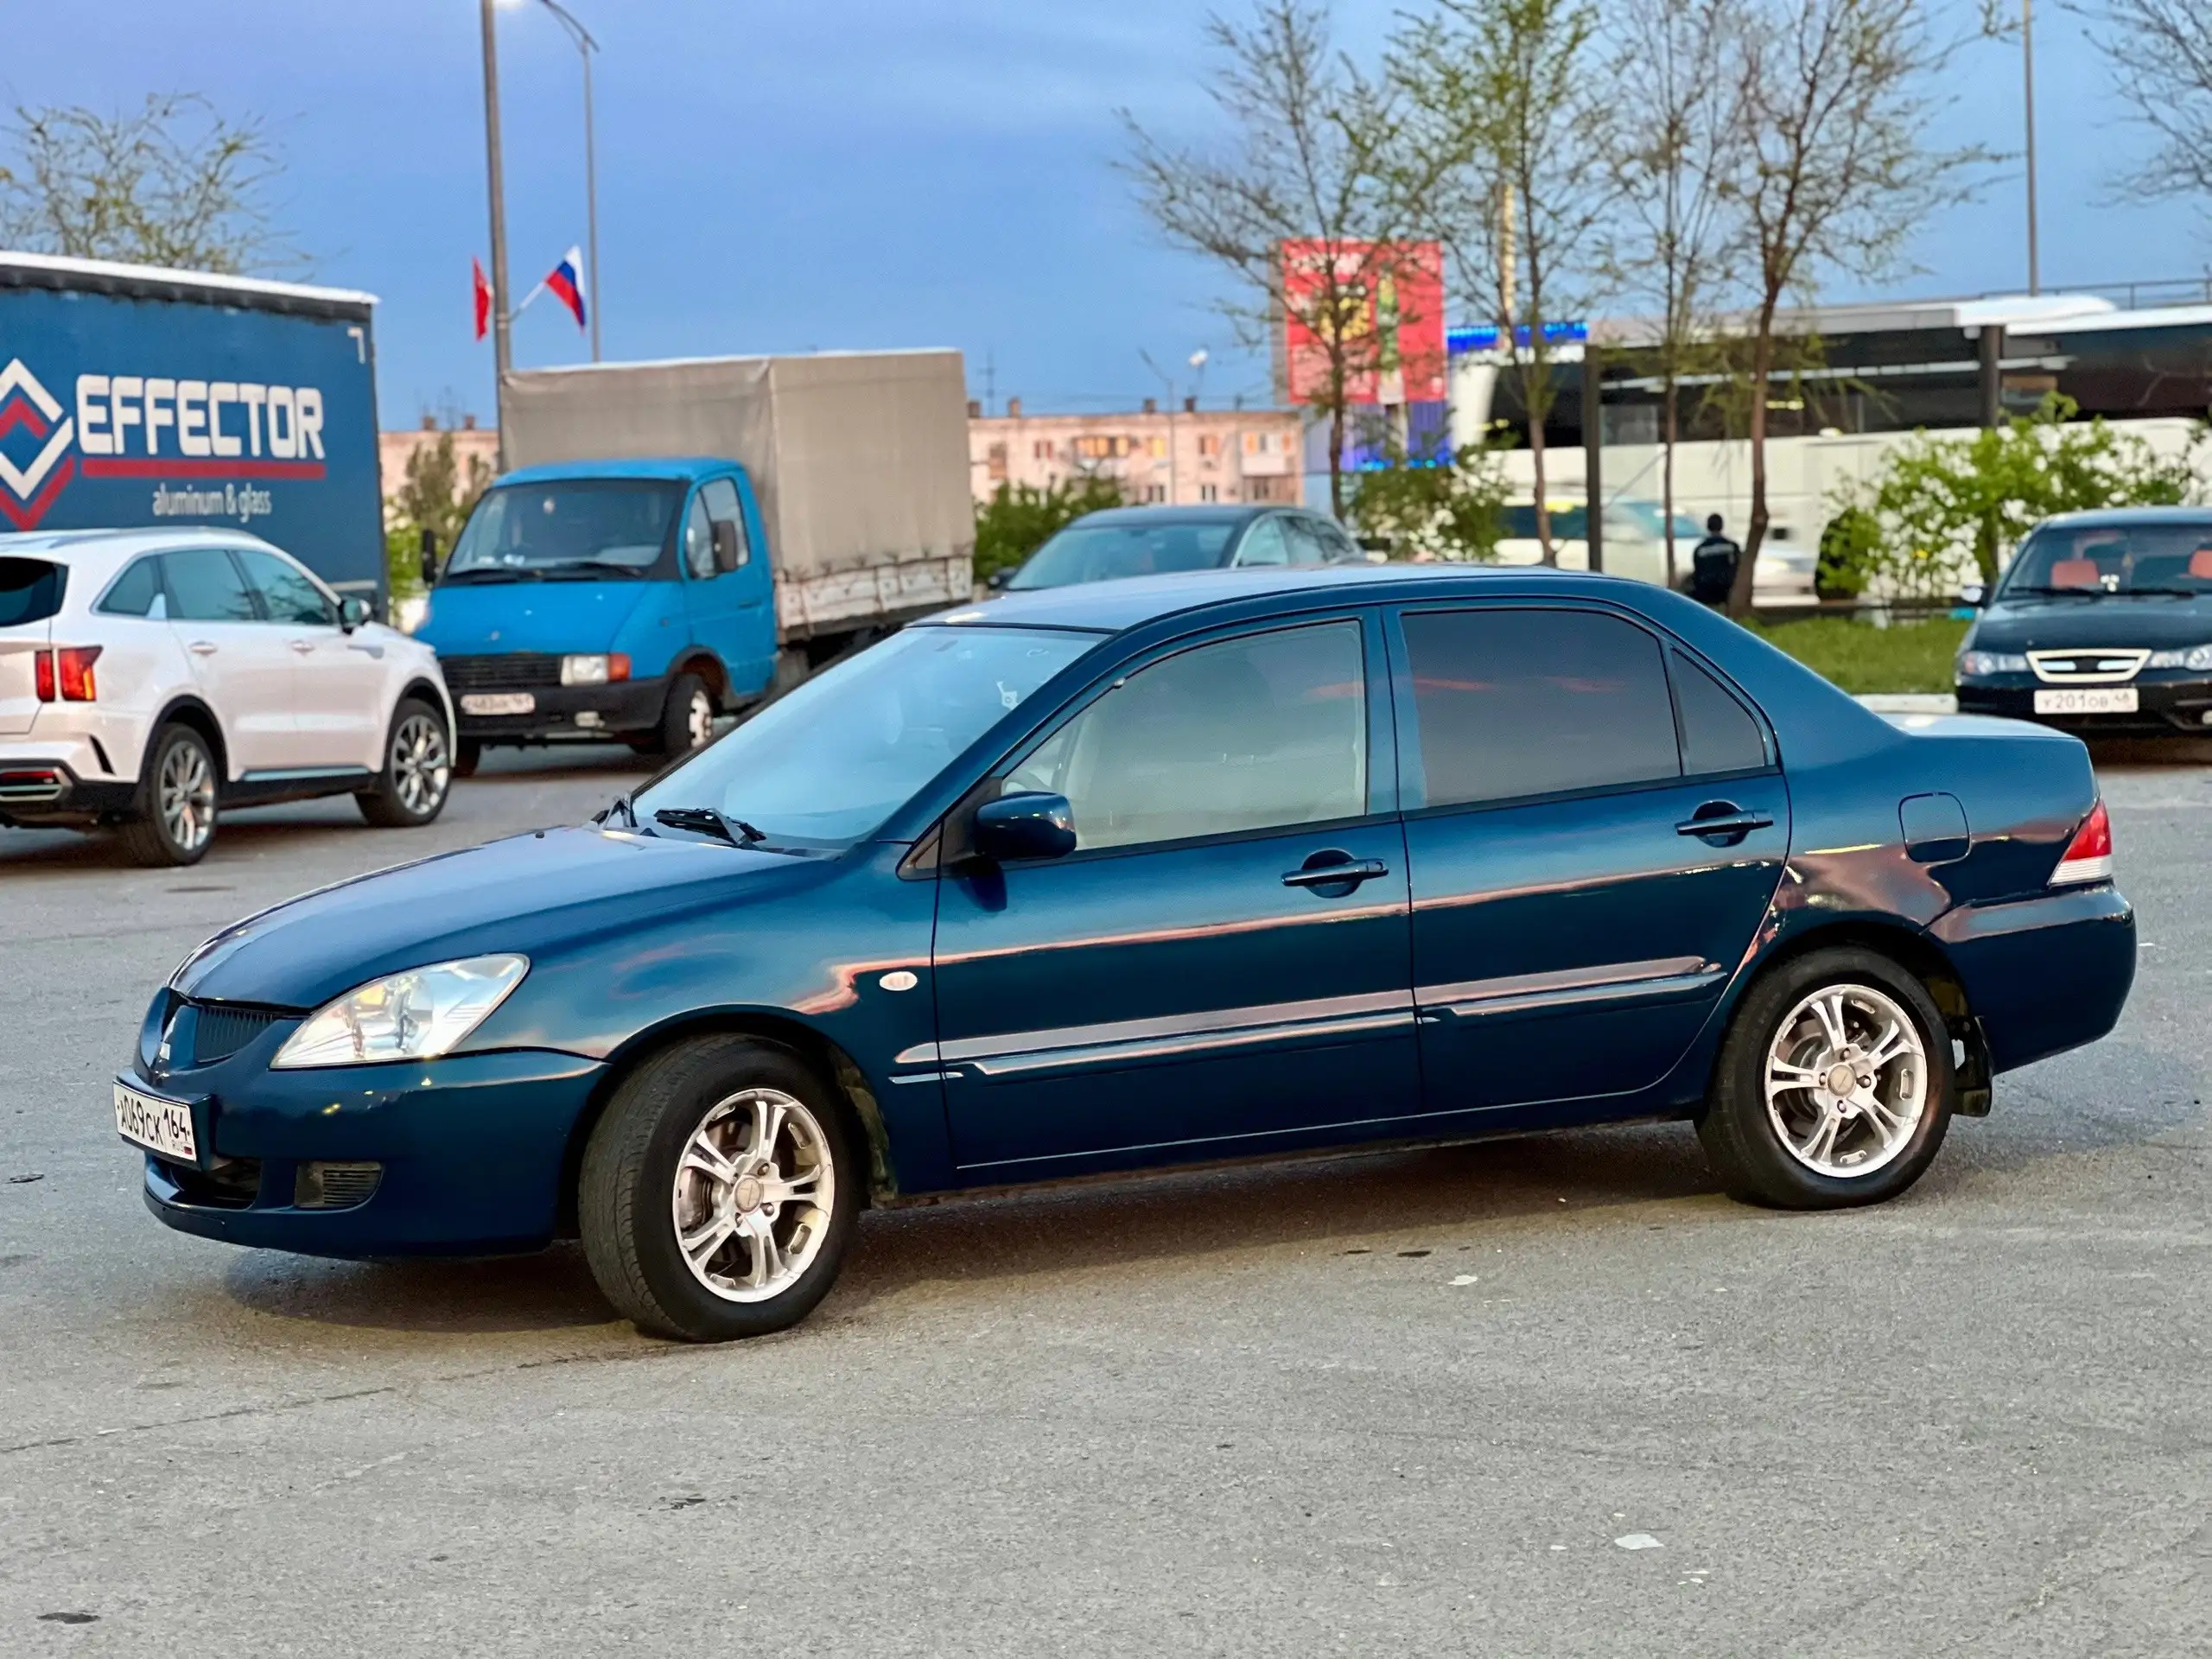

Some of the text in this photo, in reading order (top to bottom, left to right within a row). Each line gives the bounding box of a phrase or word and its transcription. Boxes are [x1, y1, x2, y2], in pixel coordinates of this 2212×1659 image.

[76, 374, 326, 460] EFFECTOR
[153, 482, 273, 523] aluminum & glass
[163, 1108, 188, 1141] 164
